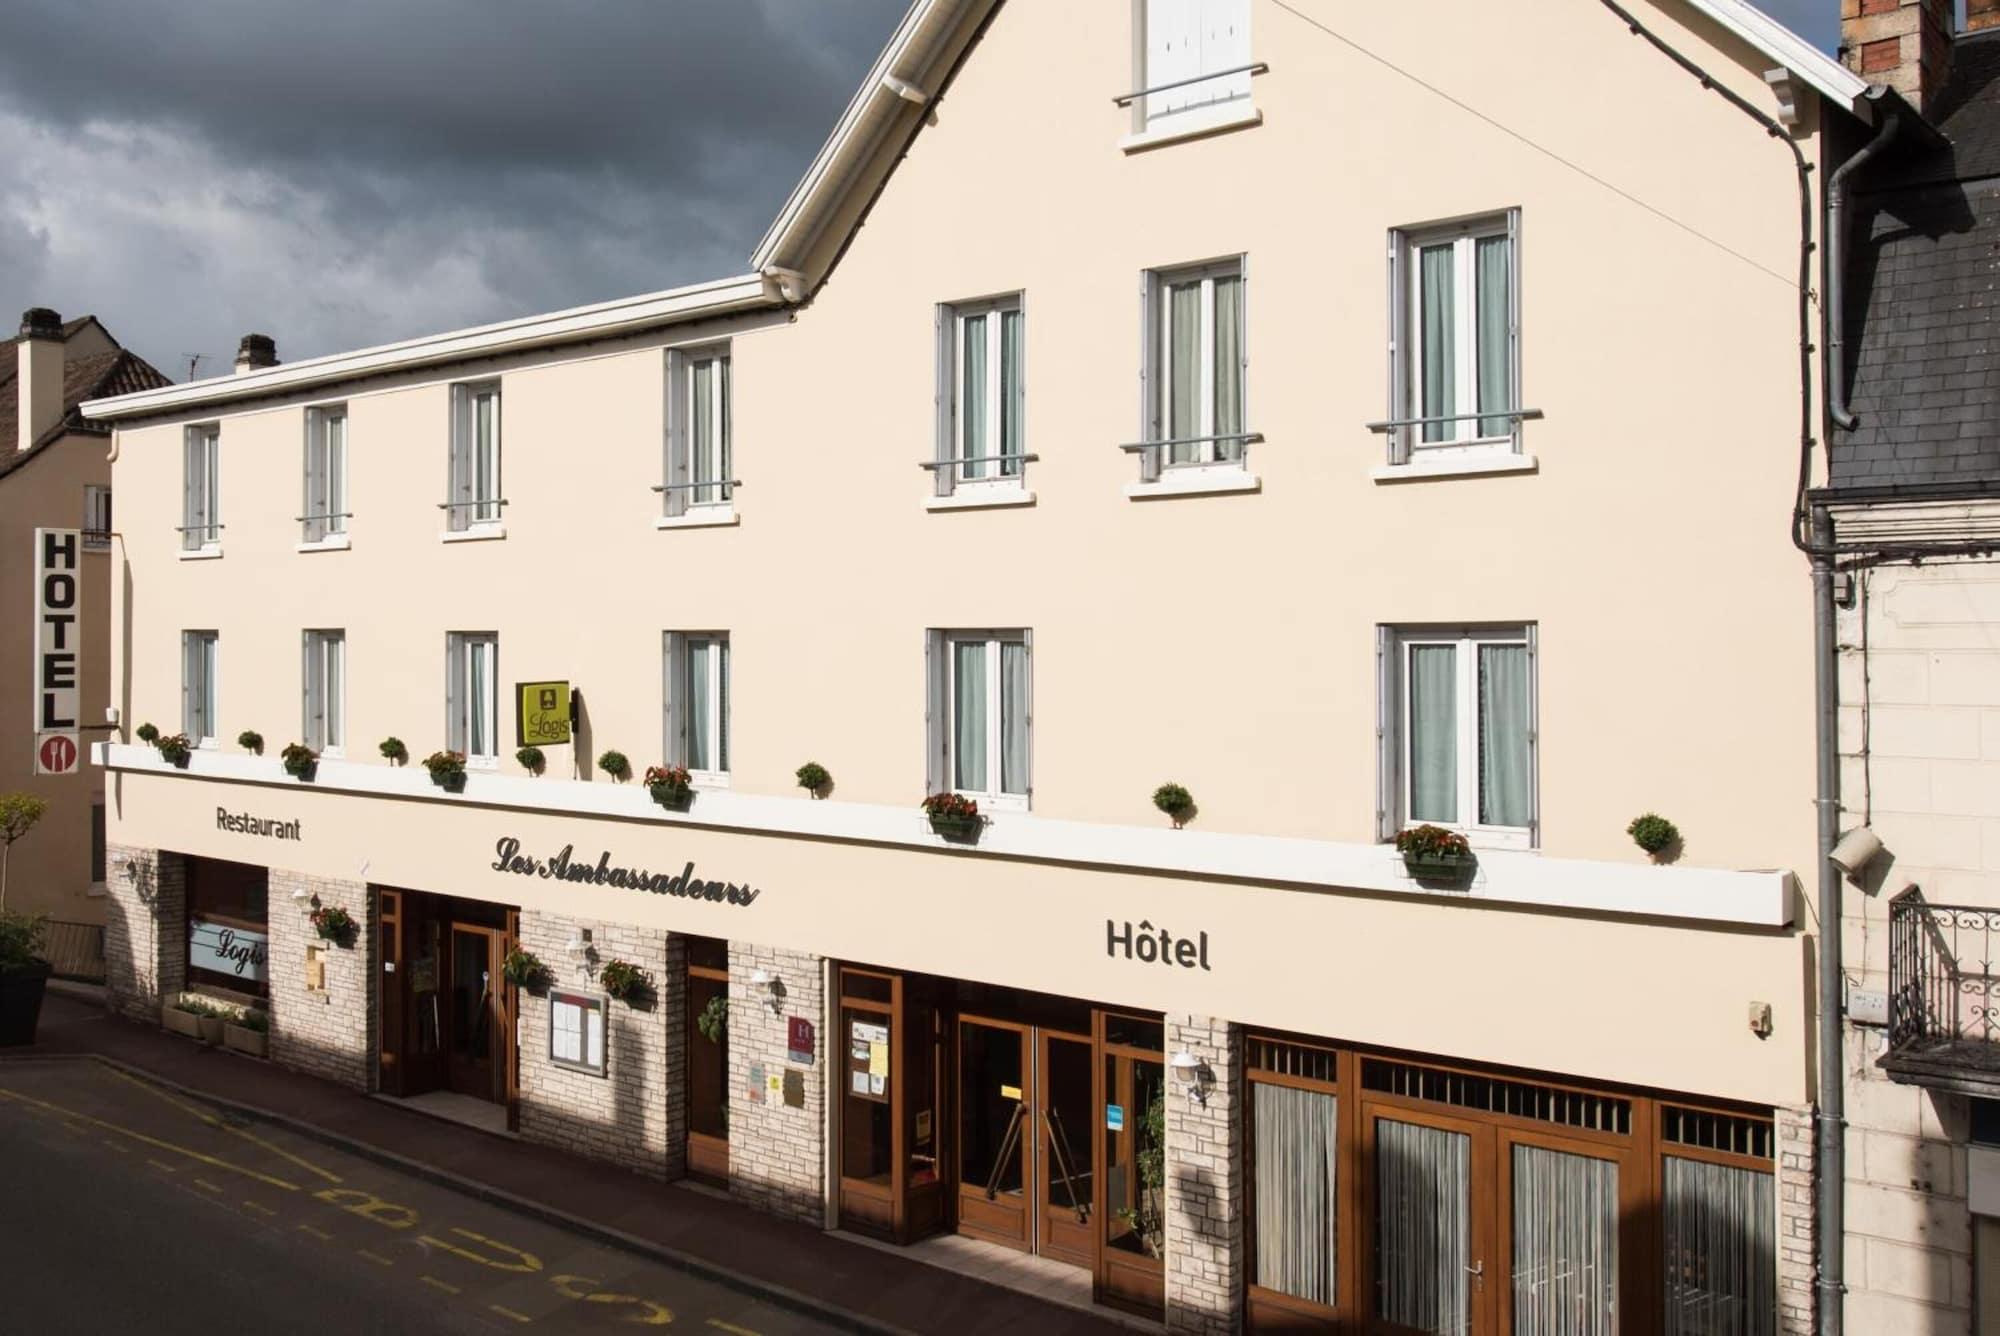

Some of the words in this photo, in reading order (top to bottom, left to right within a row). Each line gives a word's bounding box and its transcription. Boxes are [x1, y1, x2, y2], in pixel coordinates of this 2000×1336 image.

[43, 533, 75, 729] HOTEL
[528, 711, 569, 740] Logis
[216, 806, 301, 841] Restaurant
[491, 836, 541, 876] Les
[538, 843, 760, 907] Ambassadeurs
[215, 928, 264, 975] Logis
[1106, 919, 1211, 971] Hôtel
[797, 1023, 810, 1039] H
[313, 1187, 675, 1325] BUS
